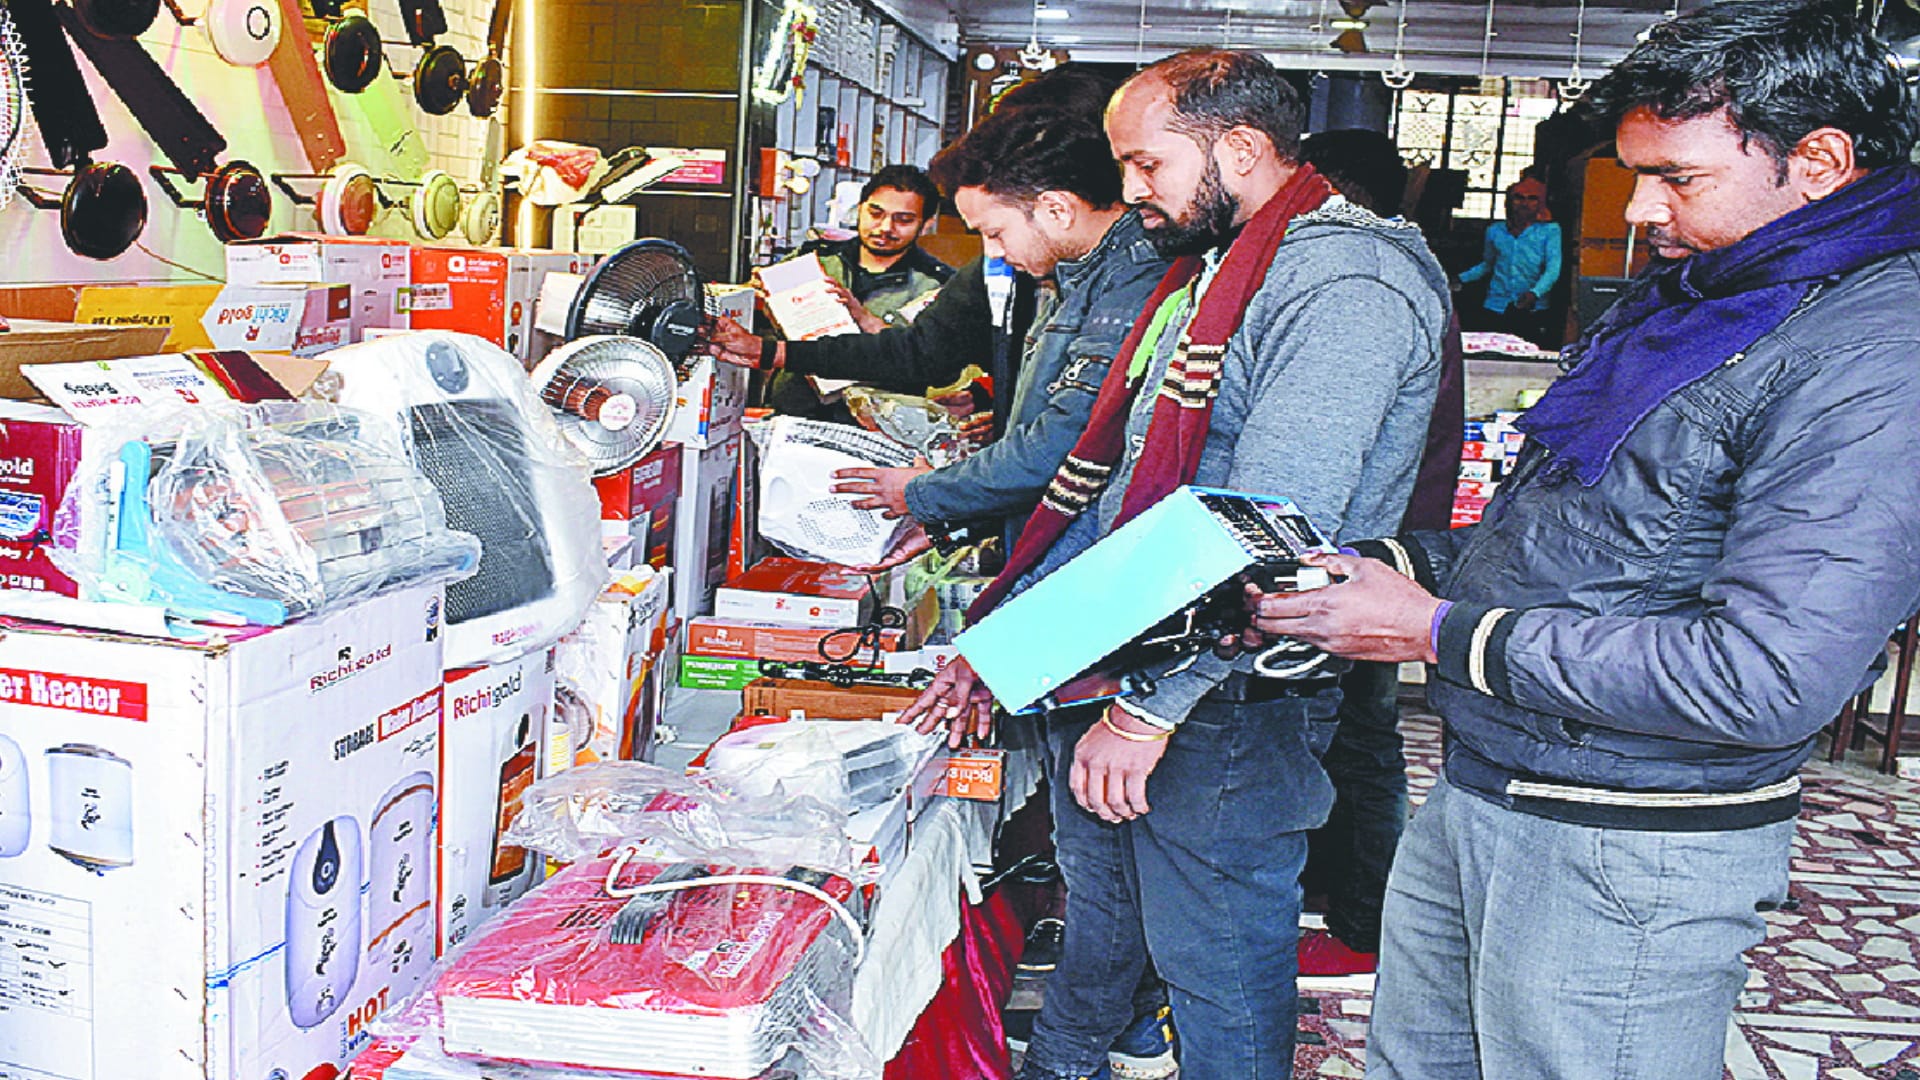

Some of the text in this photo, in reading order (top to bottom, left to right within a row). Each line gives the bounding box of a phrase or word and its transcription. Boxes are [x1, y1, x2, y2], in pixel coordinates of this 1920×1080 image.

[217, 304, 290, 324] Richigold
[310, 643, 392, 690] Richigold
[29, 672, 121, 714] Heater
[453, 671, 522, 720] Richigold
[348, 985, 390, 1037] HOT
